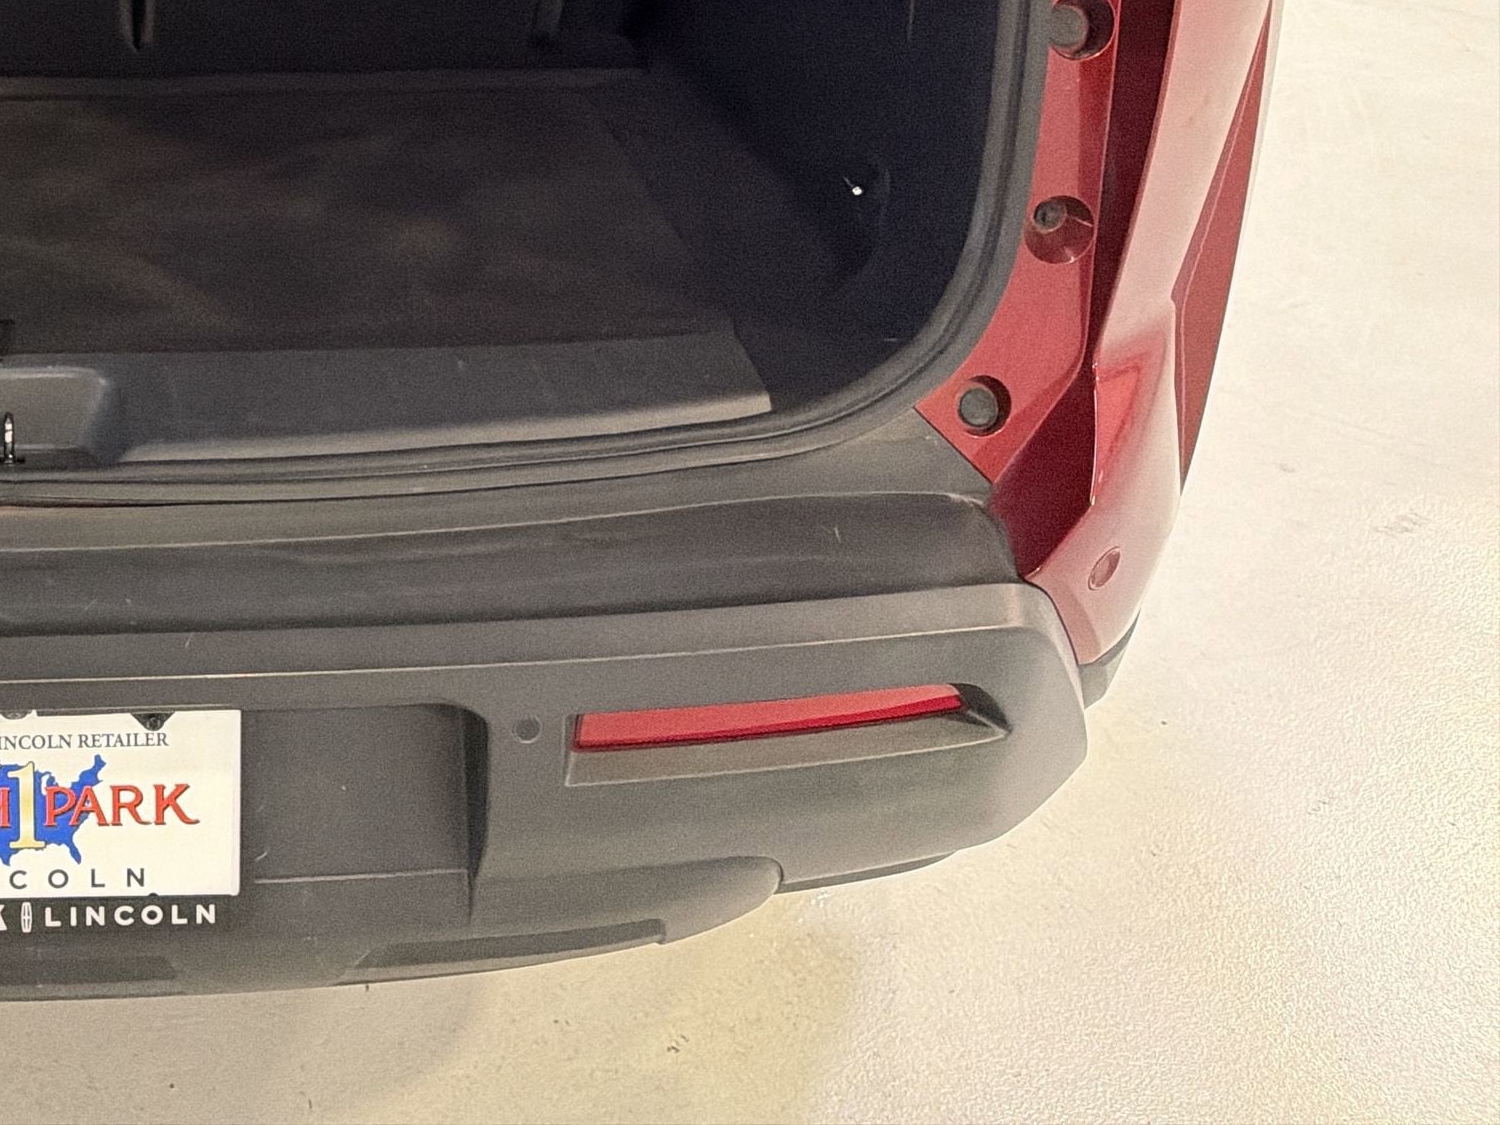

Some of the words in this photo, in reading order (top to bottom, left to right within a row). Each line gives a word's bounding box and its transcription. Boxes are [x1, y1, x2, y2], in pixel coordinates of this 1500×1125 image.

[78, 732, 169, 748] RETAILER
[45, 783, 200, 827] PARK
[44, 903, 216, 928] LINCOLN
